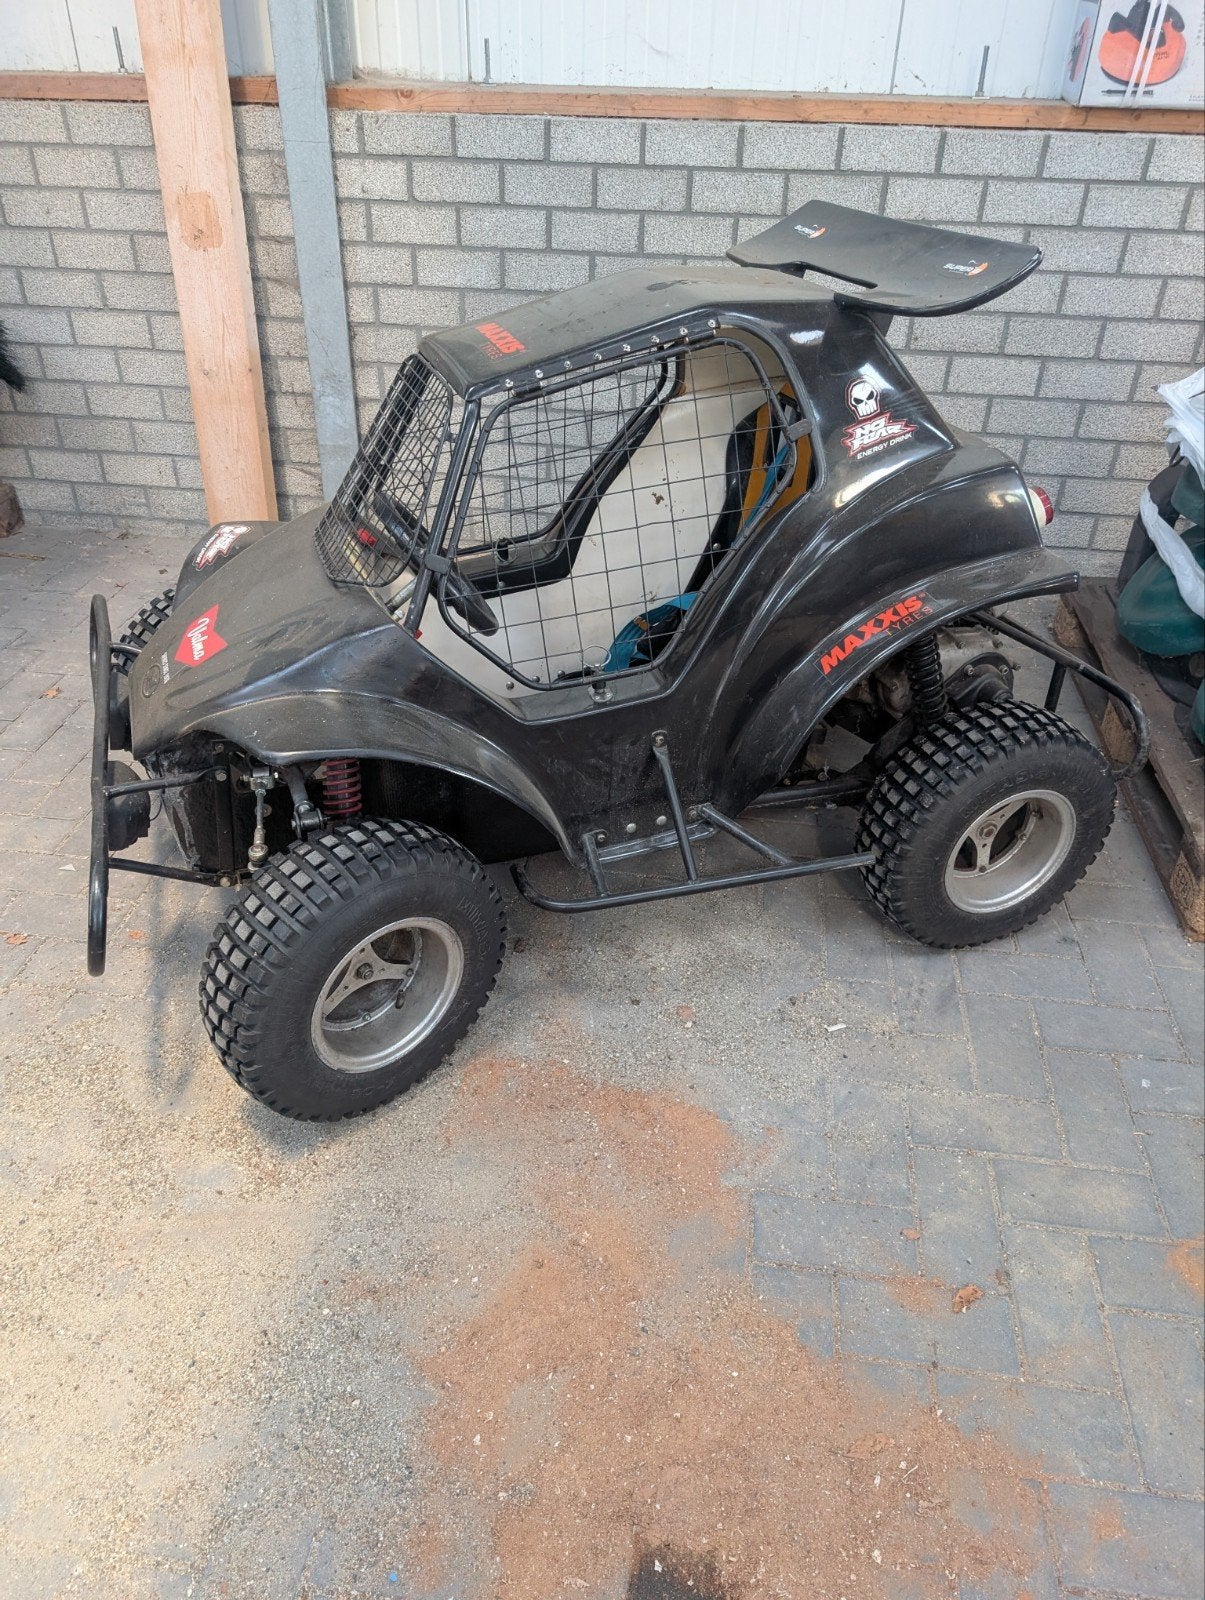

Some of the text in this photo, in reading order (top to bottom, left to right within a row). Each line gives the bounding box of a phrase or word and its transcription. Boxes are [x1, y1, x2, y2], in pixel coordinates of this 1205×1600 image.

[474, 322, 525, 354] MAXXIS
[851, 424, 905, 451] FEAR
[854, 418, 886, 438] NO
[857, 431, 912, 459] ENERGY DRINK
[820, 595, 923, 675] MAXXIS
[884, 606, 933, 637] TYRES
[187, 617, 209, 661] Valma
